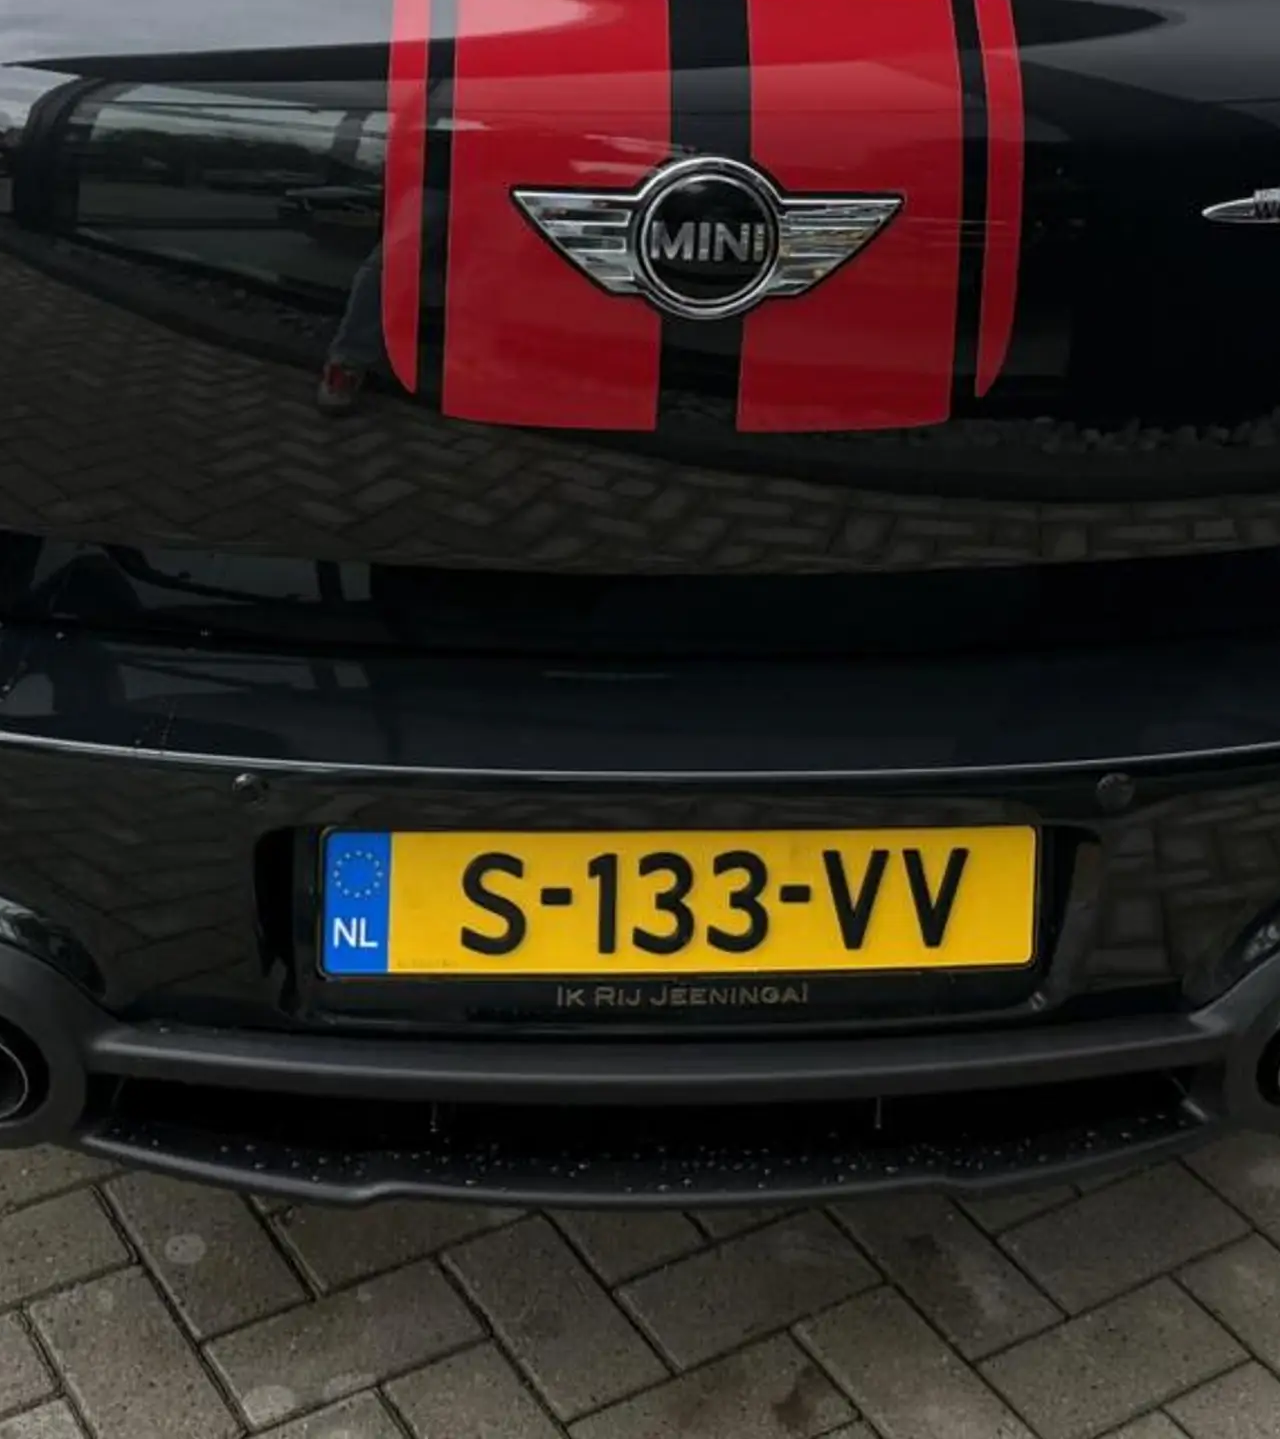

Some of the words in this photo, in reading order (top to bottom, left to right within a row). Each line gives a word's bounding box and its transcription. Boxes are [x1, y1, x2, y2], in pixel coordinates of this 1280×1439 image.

[650, 220, 766, 262] MINI
[460, 847, 970, 956] S-133-VV
[332, 918, 380, 950] NL
[556, 985, 586, 1007] IK
[594, 985, 641, 1007] RIJ
